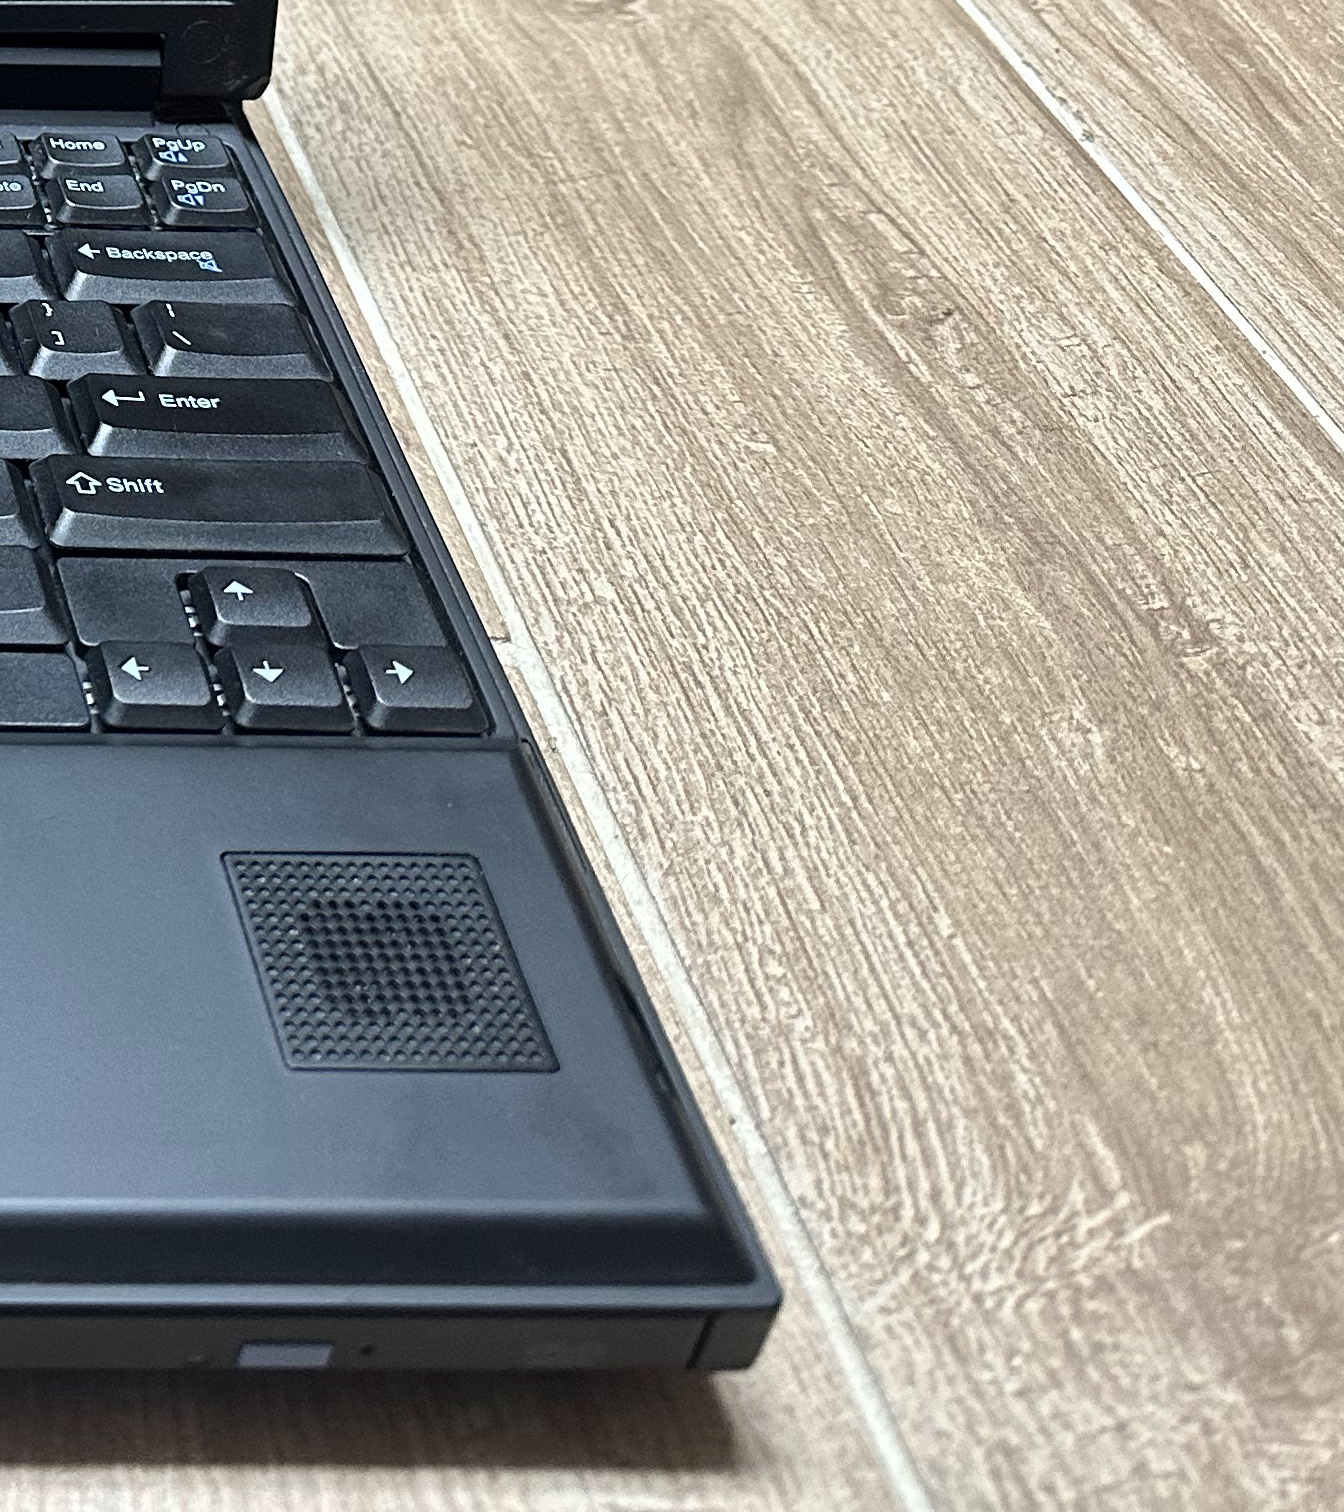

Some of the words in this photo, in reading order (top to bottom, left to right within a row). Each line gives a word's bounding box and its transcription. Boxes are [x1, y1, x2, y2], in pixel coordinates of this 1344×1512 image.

[50, 138, 105, 151] Home
[152, 138, 205, 153] PgUp
[66, 181, 104, 193] End
[171, 180, 225, 195] PgDn
[105, 247, 213, 263] Backspace
[158, 393, 221, 410] Enter
[106, 477, 164, 495] Shift
